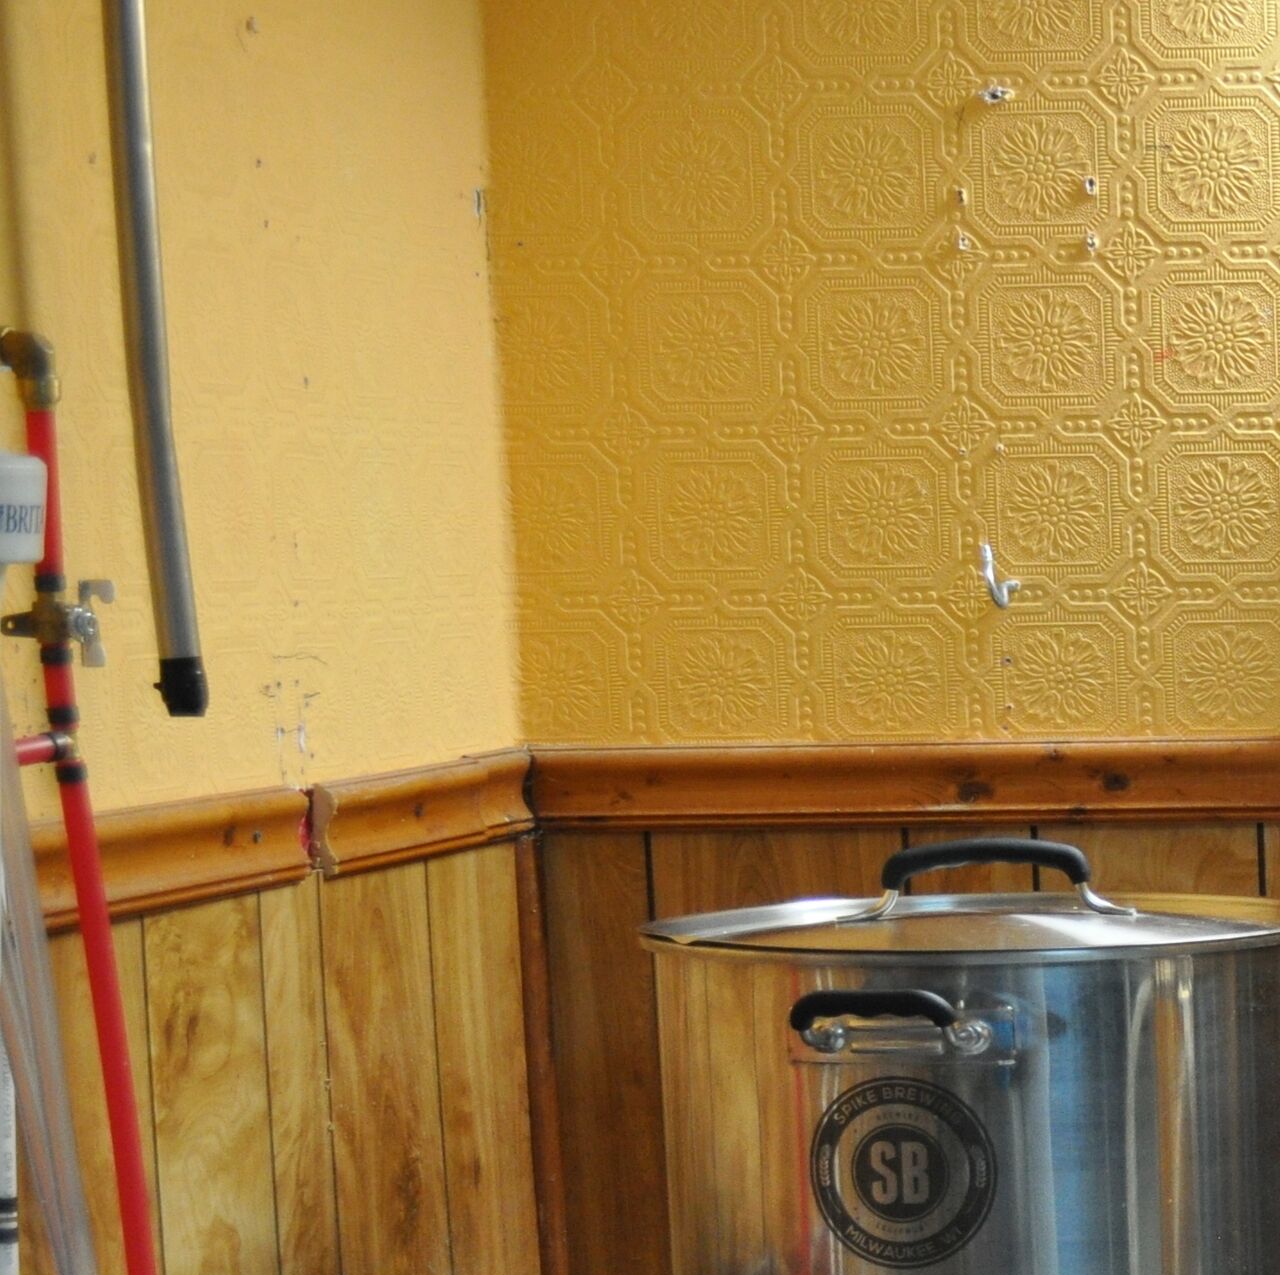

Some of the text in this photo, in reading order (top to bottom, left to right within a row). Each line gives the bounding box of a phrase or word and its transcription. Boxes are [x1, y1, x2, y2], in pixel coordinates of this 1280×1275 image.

[833, 1086, 966, 1125] SPIKE BREWING
[870, 1141, 931, 1205] SB
[942, 1226, 964, 1244] WI
